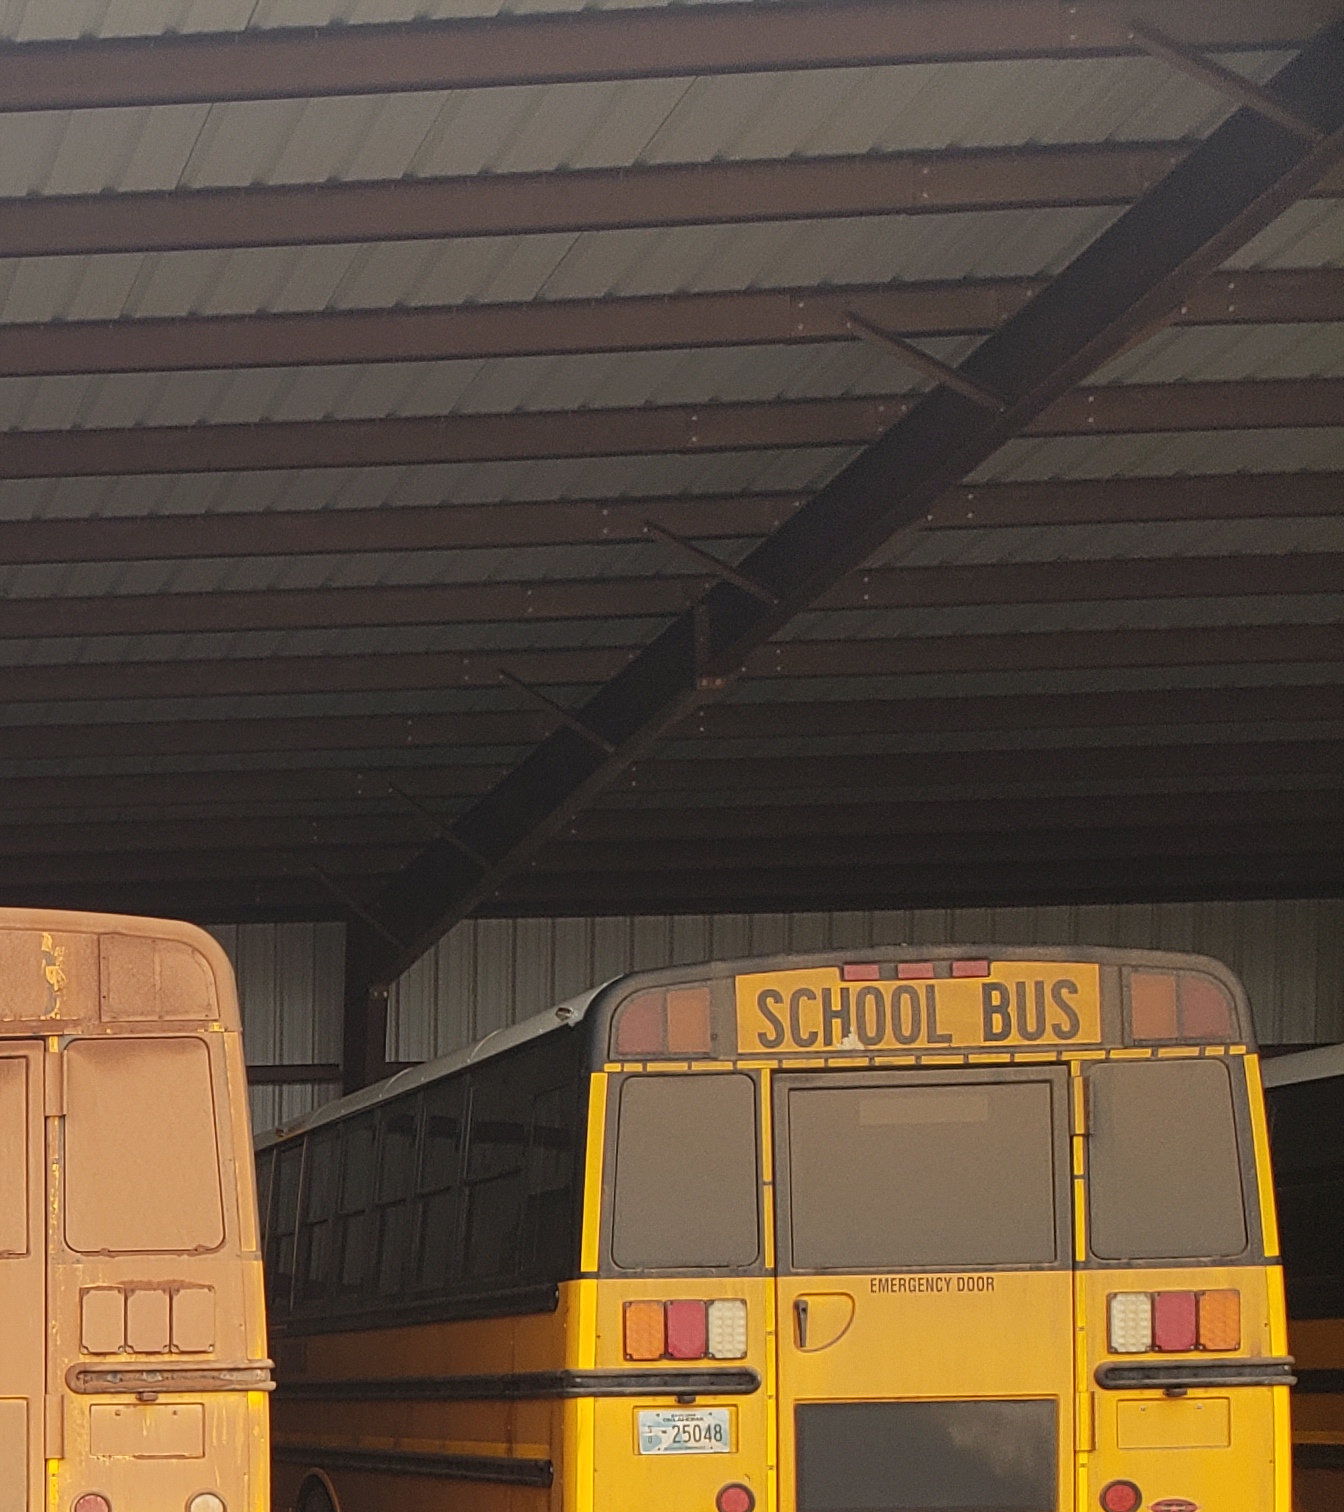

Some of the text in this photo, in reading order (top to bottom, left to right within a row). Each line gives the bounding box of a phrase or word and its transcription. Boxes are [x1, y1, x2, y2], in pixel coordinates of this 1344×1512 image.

[757, 979, 1081, 1048] SCHOOL BUS
[870, 1276, 995, 1293] EMERGENCY DOOR
[672, 1424, 723, 1443] 25048
